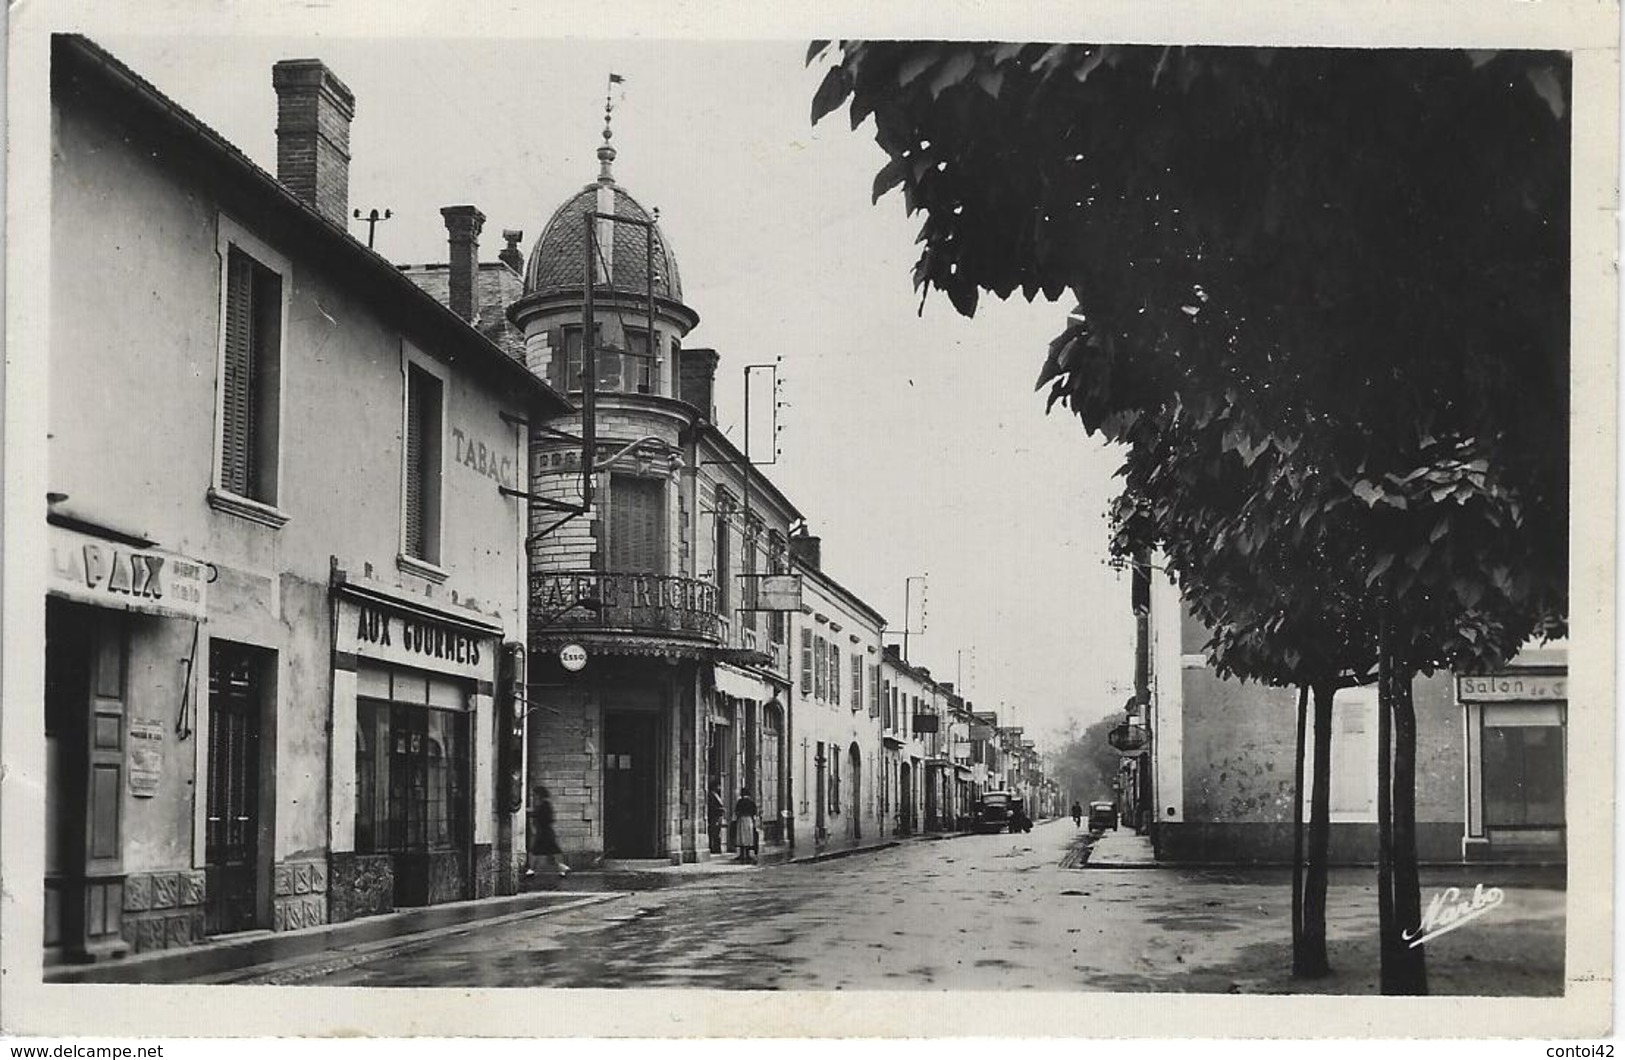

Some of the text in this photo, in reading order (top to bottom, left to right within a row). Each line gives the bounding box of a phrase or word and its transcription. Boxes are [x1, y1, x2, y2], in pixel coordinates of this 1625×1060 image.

[452, 427, 512, 487] TABAC
[83, 545, 165, 599] PAIX
[357, 604, 480, 666] AUX GOURMETS
[562, 651, 584, 662] Esso
[1465, 677, 1523, 694] Salon
